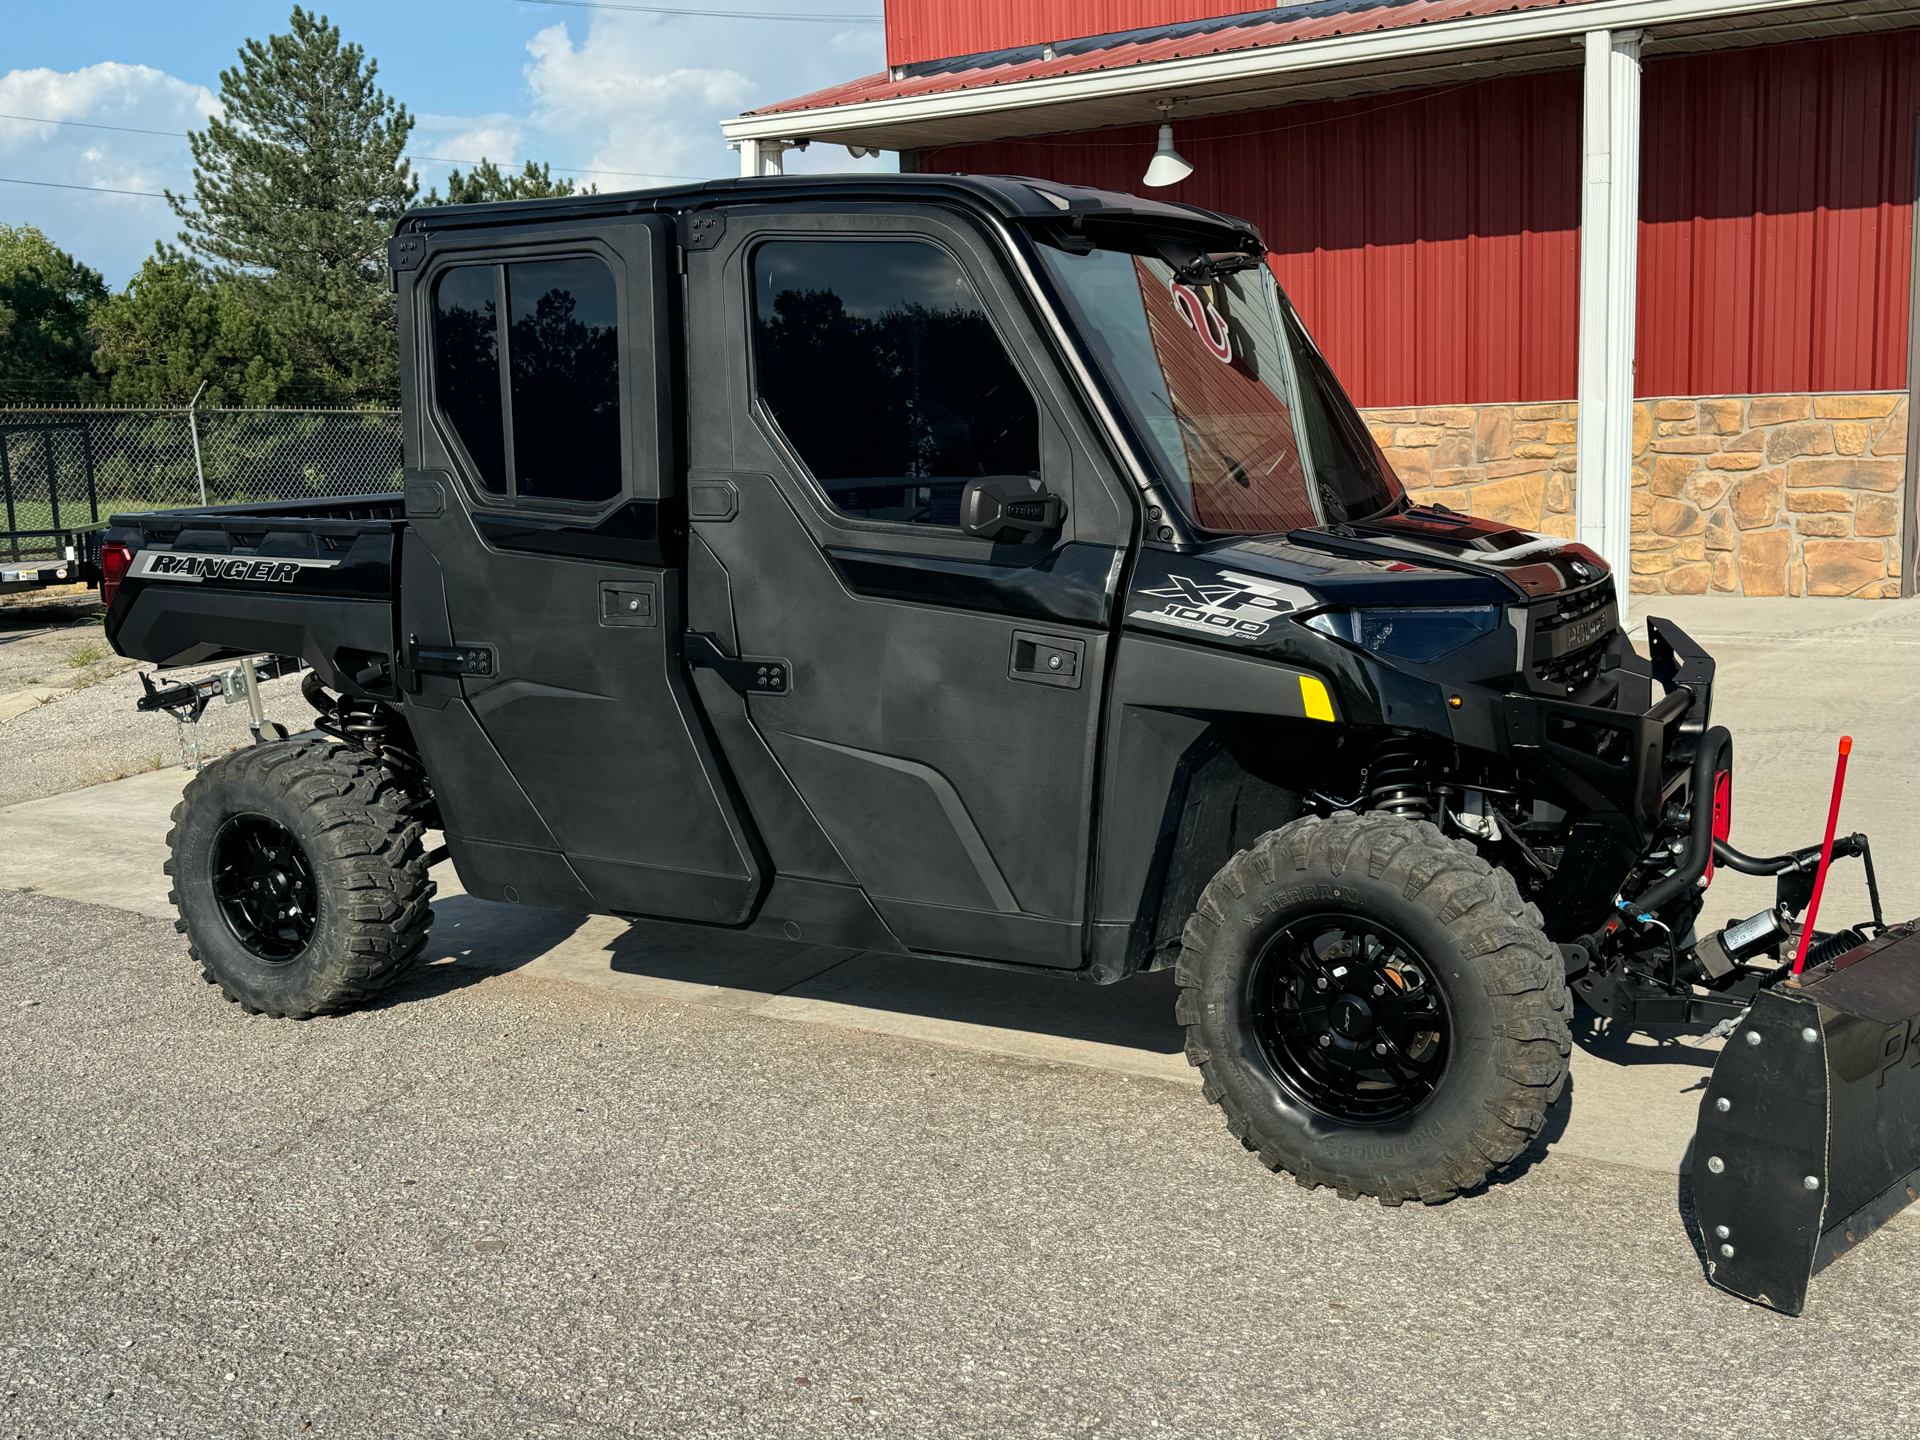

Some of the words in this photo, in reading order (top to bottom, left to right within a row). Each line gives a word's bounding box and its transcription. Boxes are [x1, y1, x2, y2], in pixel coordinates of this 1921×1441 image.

[149, 553, 300, 583] RANGER
[1137, 573, 1297, 613] XP
[1160, 616, 1182, 625] DUAL
[1235, 633, 1258, 641] CAM
[1164, 603, 1270, 636] 1000
[1242, 885, 1359, 930] X-TERRAIN
